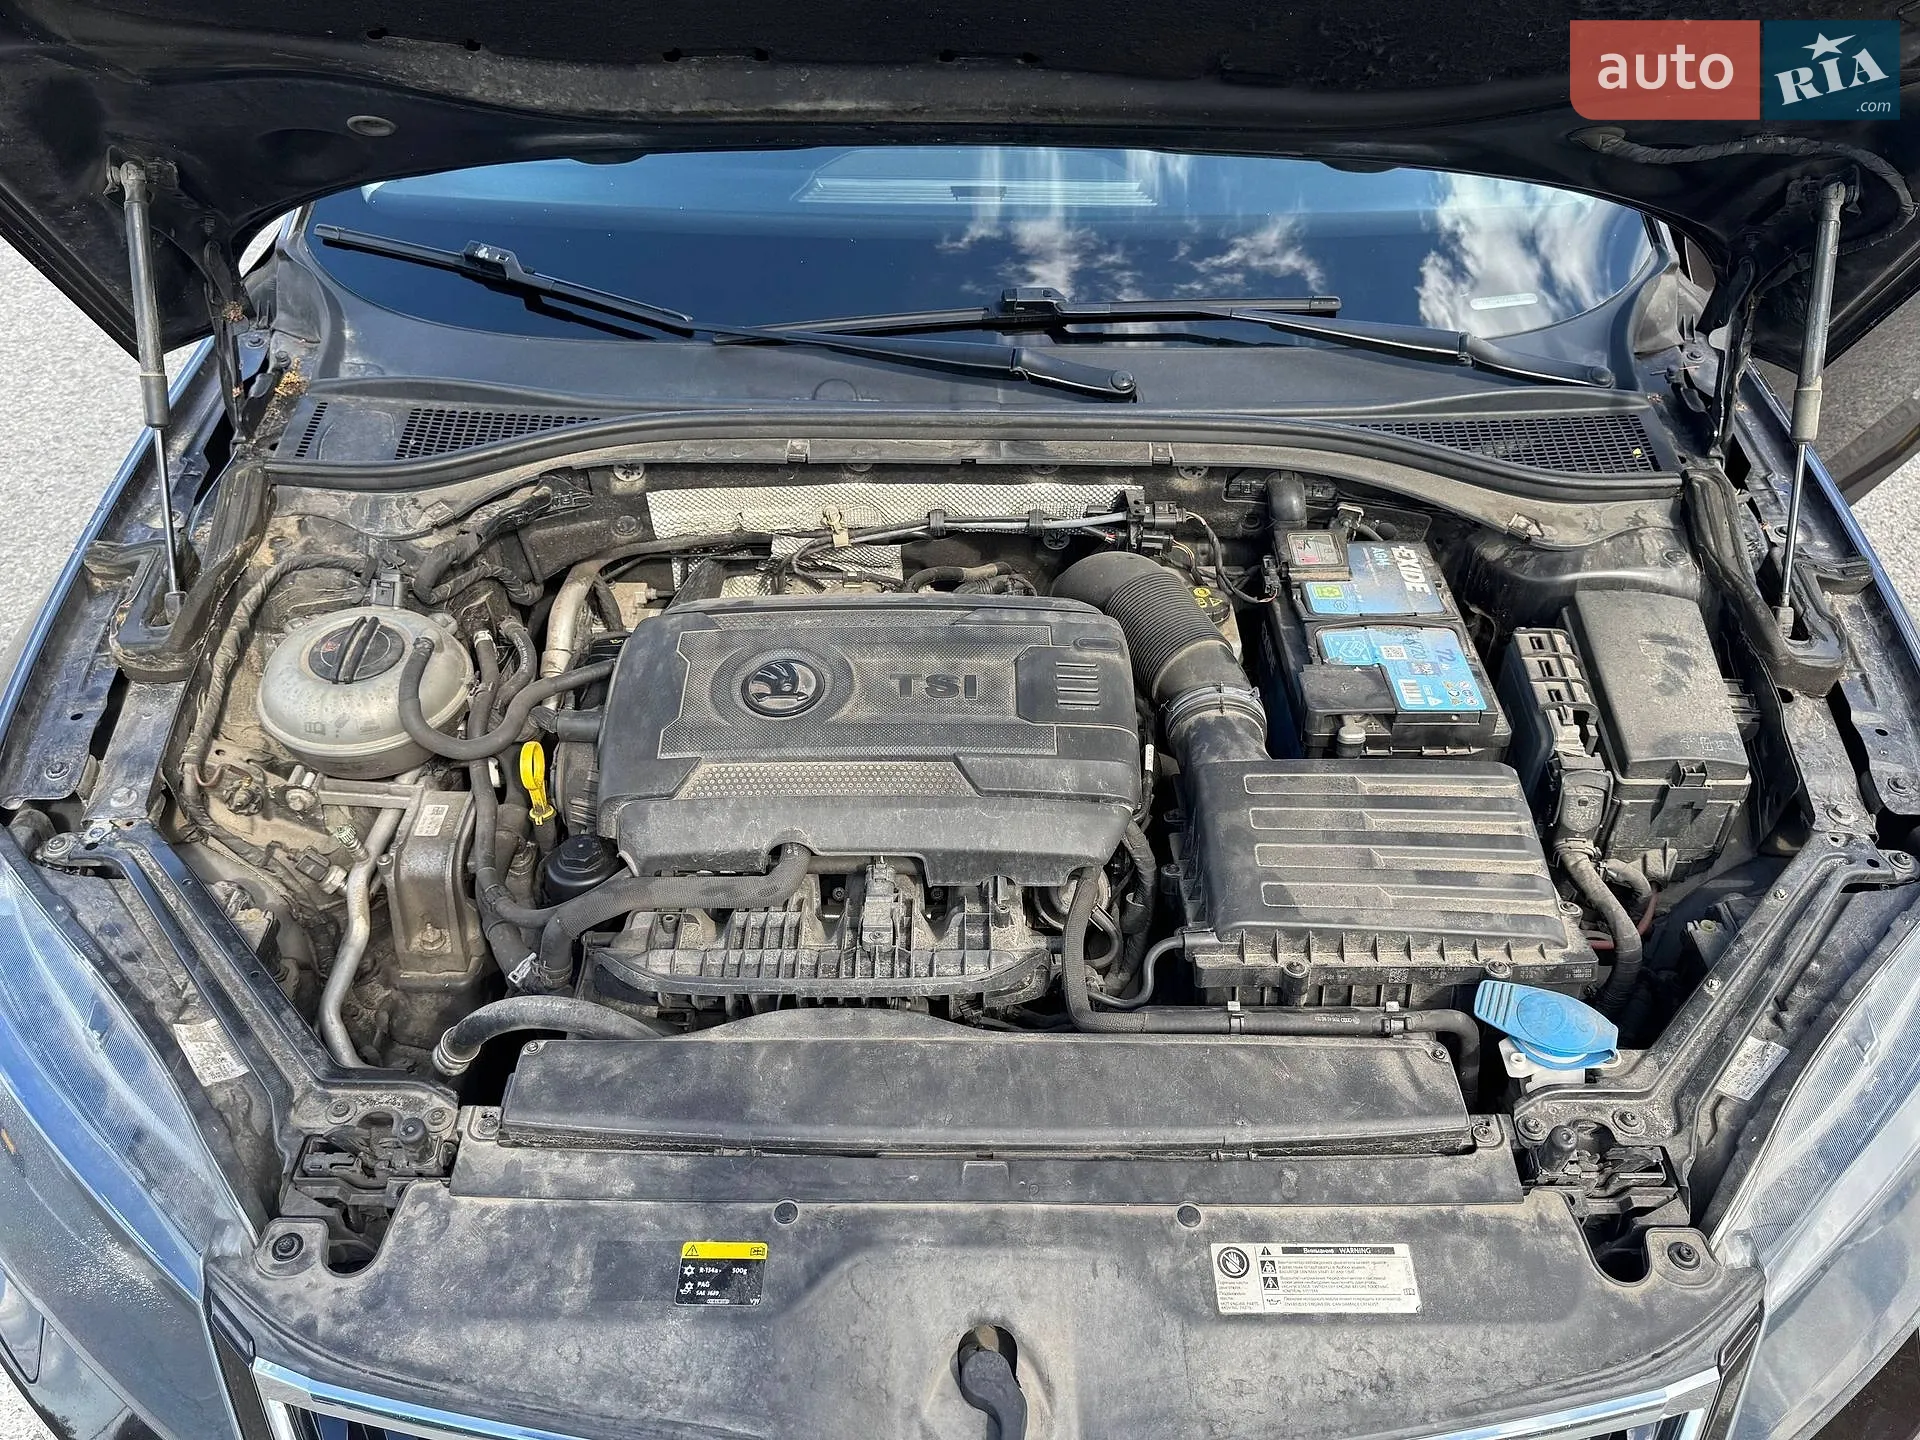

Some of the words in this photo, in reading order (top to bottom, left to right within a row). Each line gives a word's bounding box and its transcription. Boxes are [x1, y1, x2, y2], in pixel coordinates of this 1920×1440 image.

[1370, 546, 1391, 566] AGM
[1390, 545, 1432, 596] EXIDE
[889, 672, 978, 700] TSI
[732, 1267, 748, 1275] 500g
